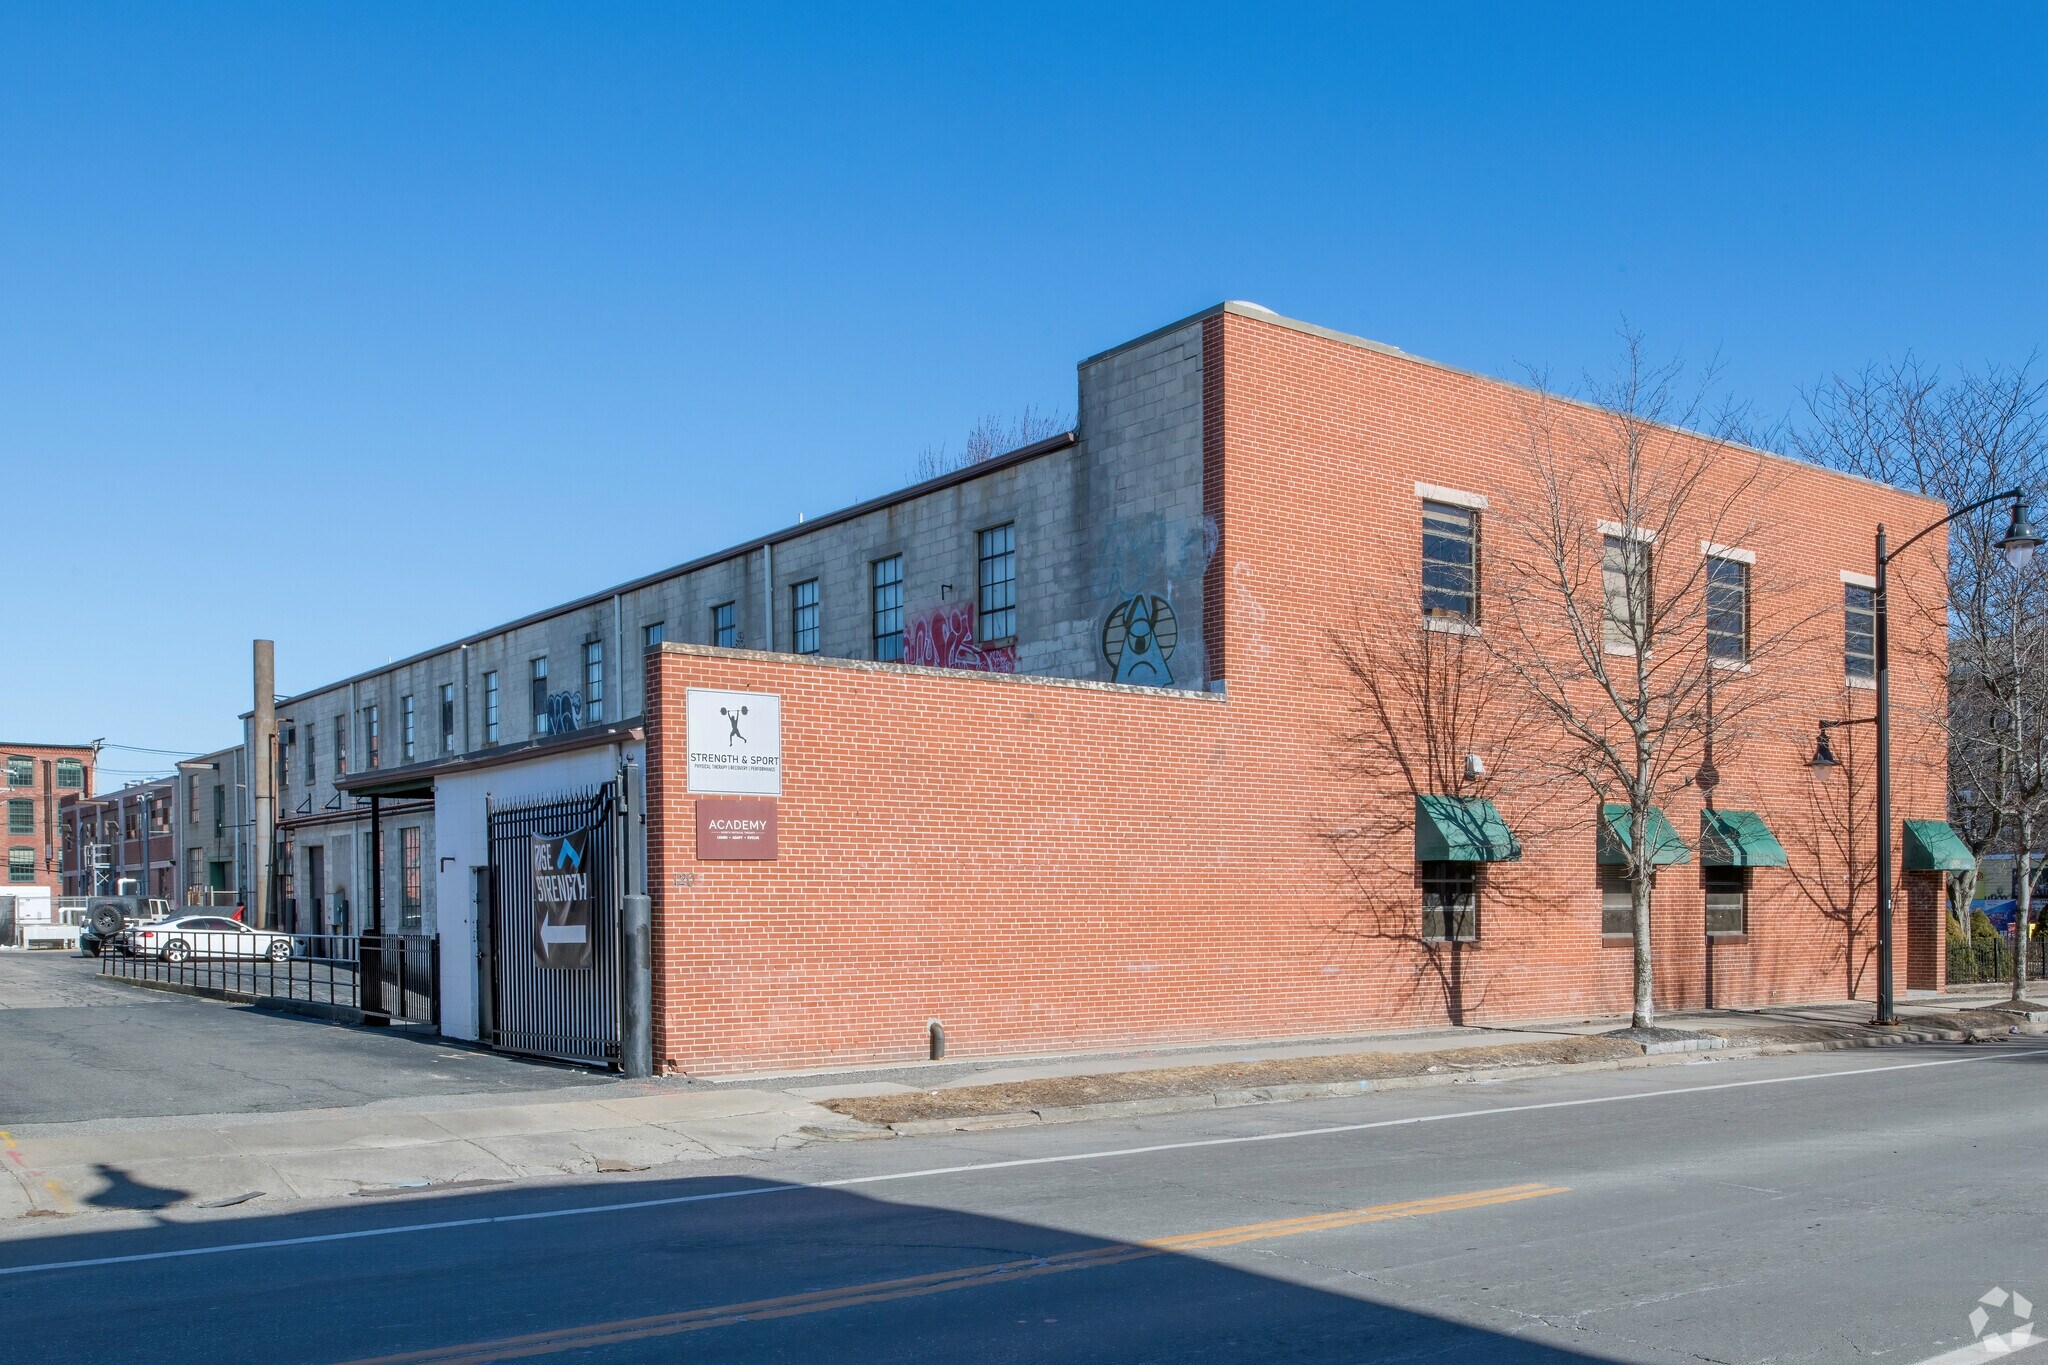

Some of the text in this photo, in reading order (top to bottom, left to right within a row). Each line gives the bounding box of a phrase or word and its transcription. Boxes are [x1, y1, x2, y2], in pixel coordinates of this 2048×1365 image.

[690, 752, 779, 766] STRENGTH & SPORT
[708, 819, 767, 830] ACADEMY
[535, 843, 553, 871] RISE
[535, 873, 587, 902] STRENGTH
